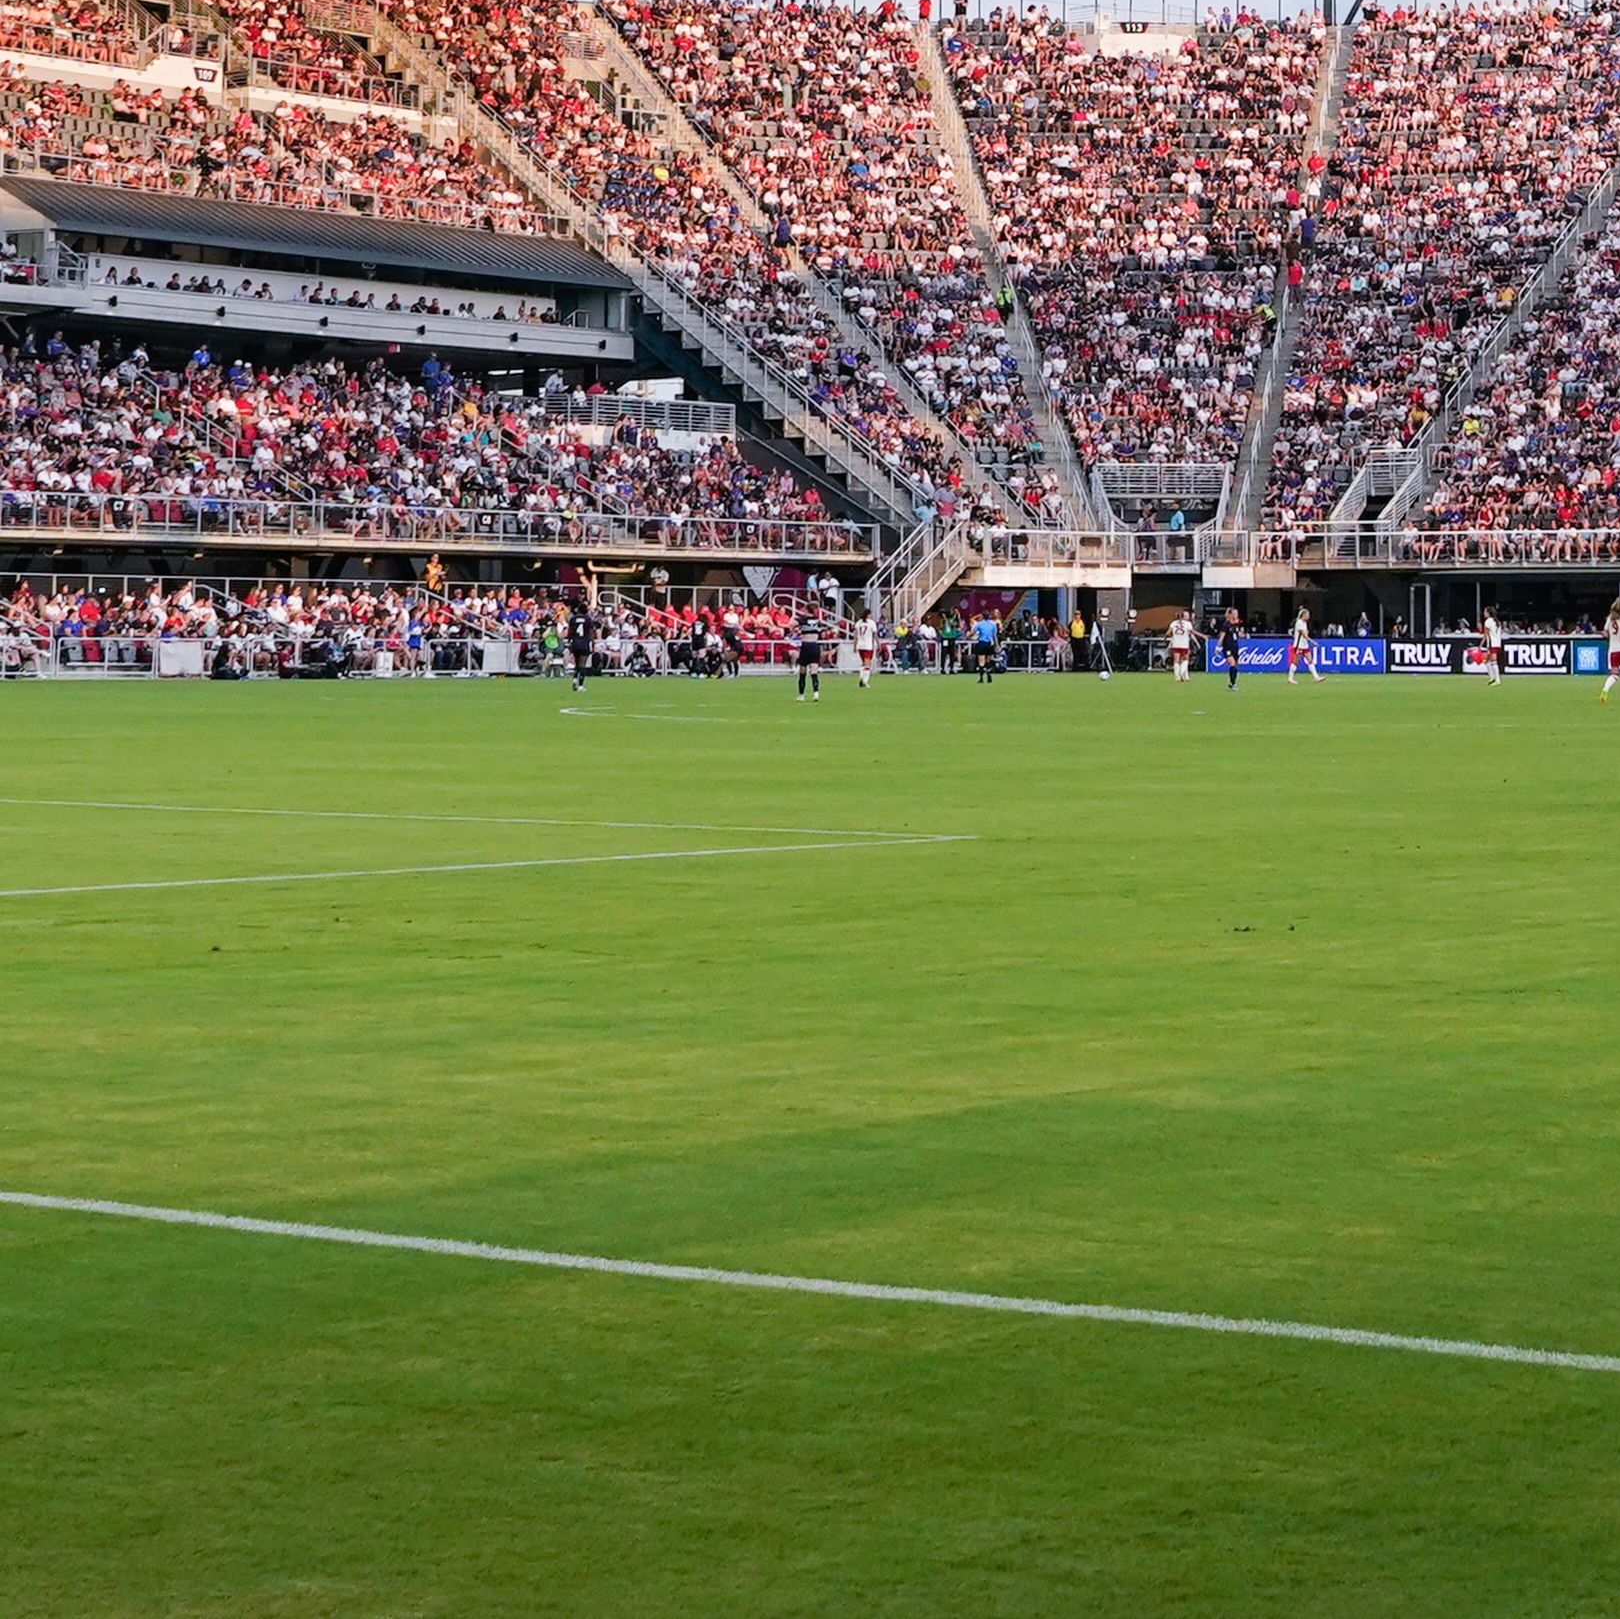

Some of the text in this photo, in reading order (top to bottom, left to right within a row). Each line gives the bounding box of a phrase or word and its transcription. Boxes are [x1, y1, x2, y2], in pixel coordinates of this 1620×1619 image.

[1124, 23, 1143, 32] 113
[1212, 646, 1285, 667] ichelob
[1390, 643, 1452, 665] TRULY
[1504, 644, 1567, 665] TRULY
